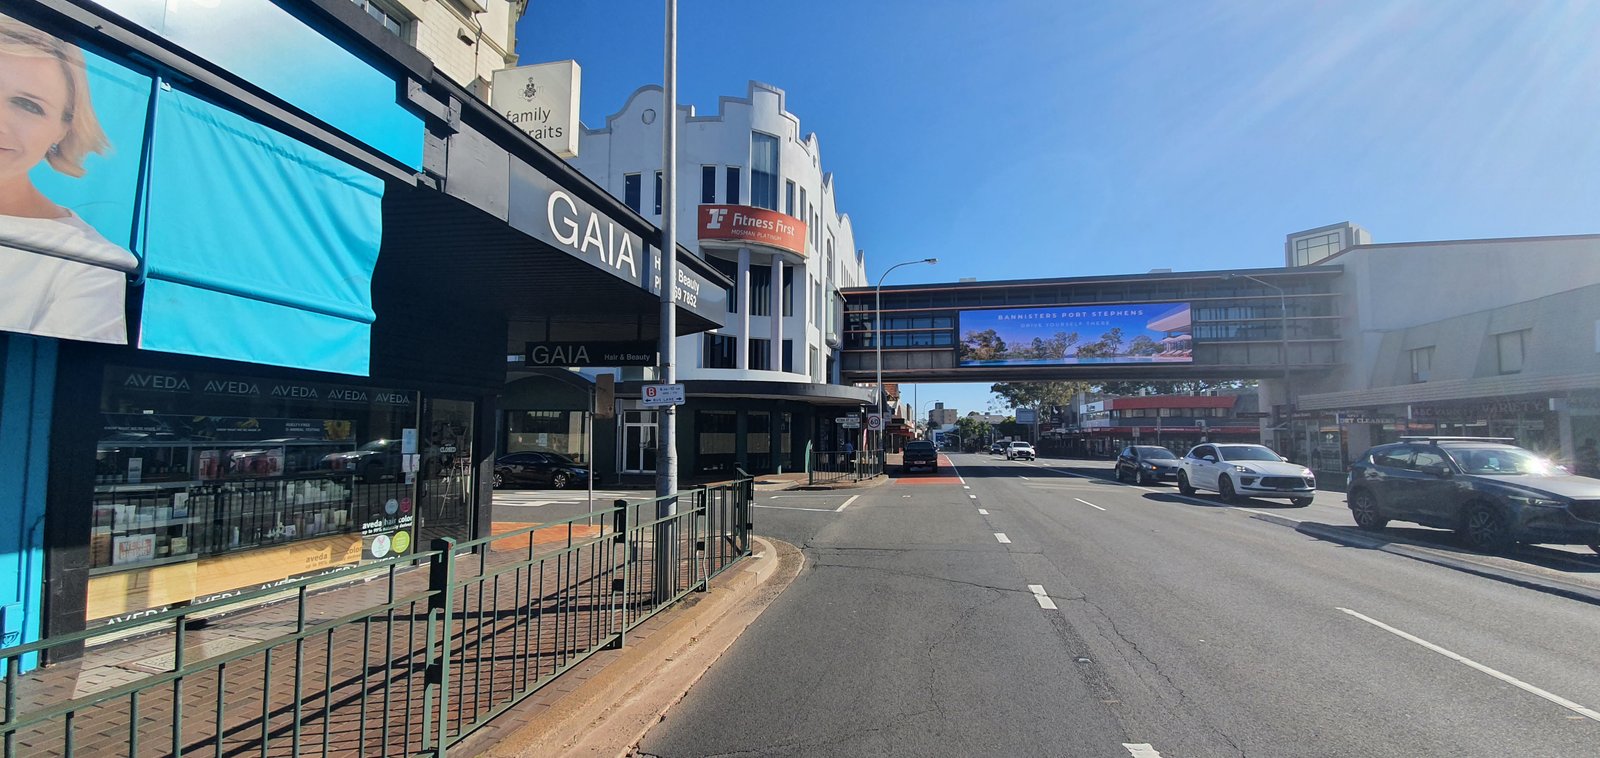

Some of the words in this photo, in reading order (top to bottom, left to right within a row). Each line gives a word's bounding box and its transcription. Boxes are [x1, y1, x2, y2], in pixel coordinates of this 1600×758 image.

[506, 106, 551, 124] family
[524, 125, 563, 140] raits
[547, 190, 637, 278] GAIA
[731, 228, 755, 237] MOSMAN
[757, 231, 783, 241] PLATINUM
[678, 268, 700, 296] Beauty
[682, 290, 697, 308] 7852
[998, 312, 1057, 321] BANNISTERS
[1061, 311, 1087, 319] PORT
[1092, 309, 1144, 318] STEPHENS
[532, 345, 590, 364] GAIA
[604, 353, 619, 361] Hair
[620, 353, 625, 361] &
[626, 353, 651, 362] Beauty
[124, 373, 190, 391] AVEDA
[204, 380, 260, 395] AVEDA
[271, 385, 318, 399] AVEDA
[328, 389, 368, 401] AVEDA
[375, 392, 410, 405] AVEDA
[362, 519, 383, 530] aveda
[384, 517, 397, 526] hair
[398, 514, 413, 524] color
[305, 552, 328, 563] aveda
